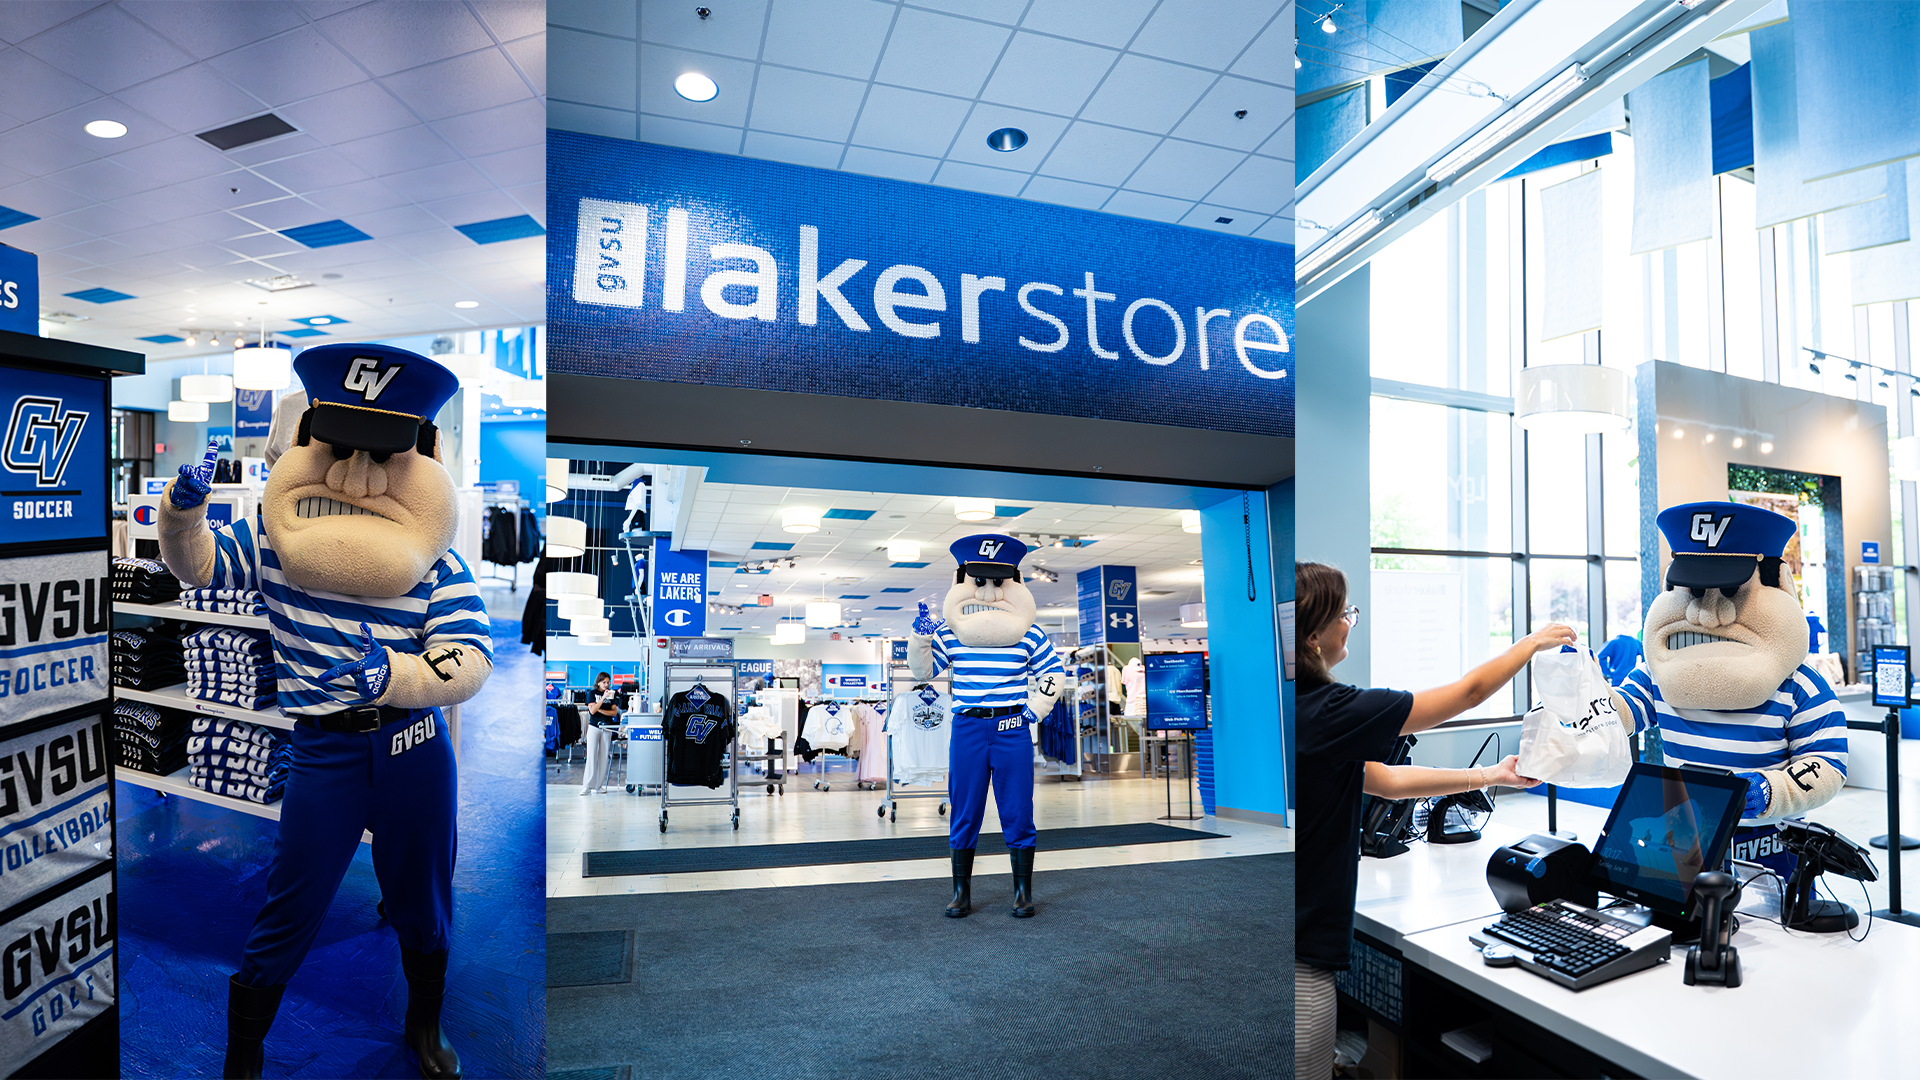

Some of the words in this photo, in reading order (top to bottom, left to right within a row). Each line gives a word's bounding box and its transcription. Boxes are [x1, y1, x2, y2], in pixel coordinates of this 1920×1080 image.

[596, 216, 626, 292] gvsu
[0, 280, 19, 309] S
[663, 207, 1290, 379] lakerstore
[343, 357, 402, 402] GV
[1, 395, 89, 487] GV
[13, 501, 73, 519] SOCCER
[1690, 513, 1732, 547] GV
[978, 539, 1005, 560] GV
[660, 586, 701, 600] LAKERS
[661, 572, 678, 583] WE
[680, 573, 701, 584] ARE
[1109, 579, 1133, 601] GV
[0, 577, 109, 646] GVSU
[0, 655, 95, 698] SOCCER
[372, 664, 388, 694] adidas
[739, 662, 772, 673] EAGUE
[113, 701, 161, 731] AKERS
[685, 714, 718, 744] GV
[998, 715, 1022, 732] GVSU
[391, 712, 436, 757] GVSU
[0, 723, 106, 818] GVSU
[1736, 832, 1784, 860] GVSU
[3, 892, 114, 1000] GVSU
[32, 975, 94, 1037] GOLF
